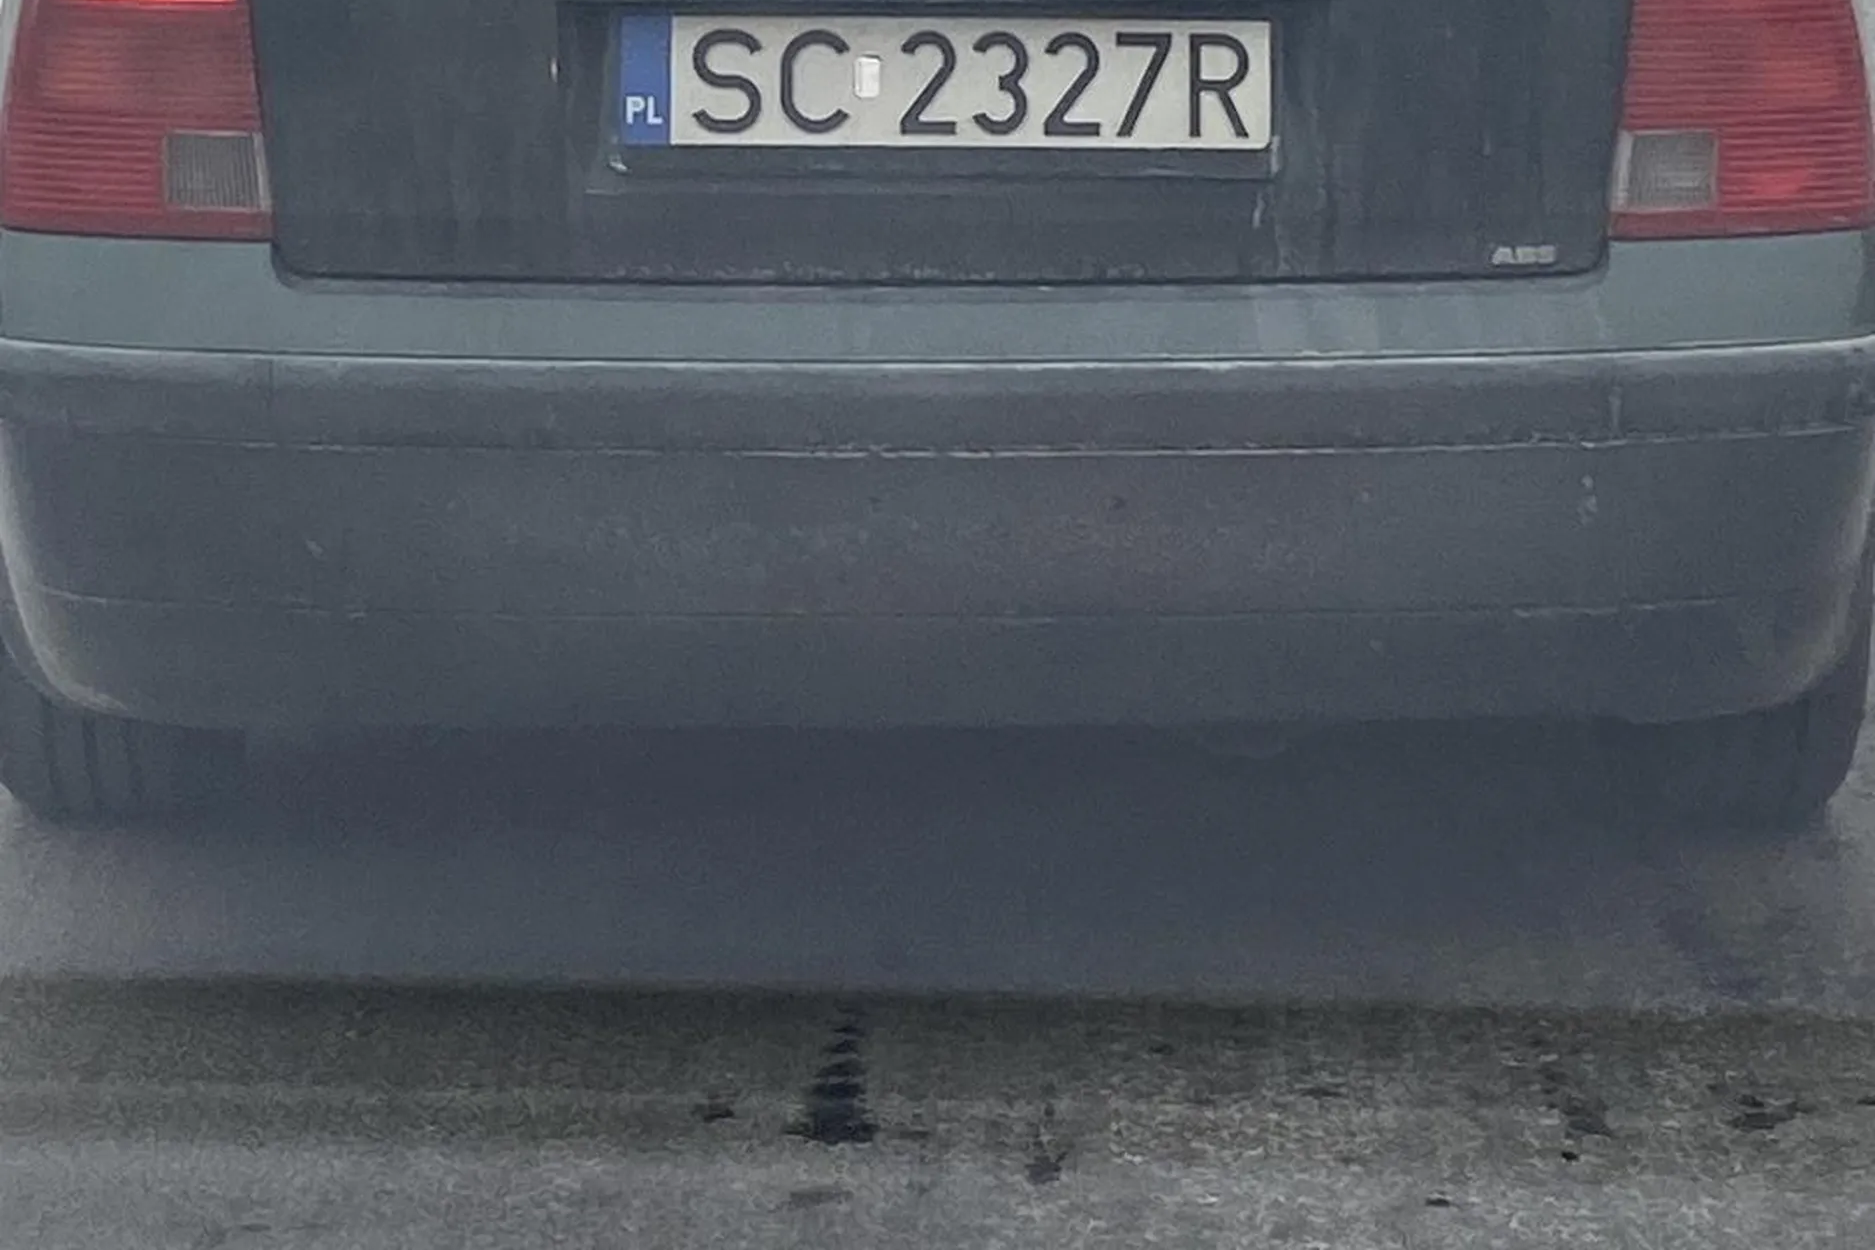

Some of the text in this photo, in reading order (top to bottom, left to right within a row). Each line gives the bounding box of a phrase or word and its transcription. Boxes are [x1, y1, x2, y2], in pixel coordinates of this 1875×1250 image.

[624, 96, 663, 125] PL
[693, 28, 1250, 138] SC 2327R
